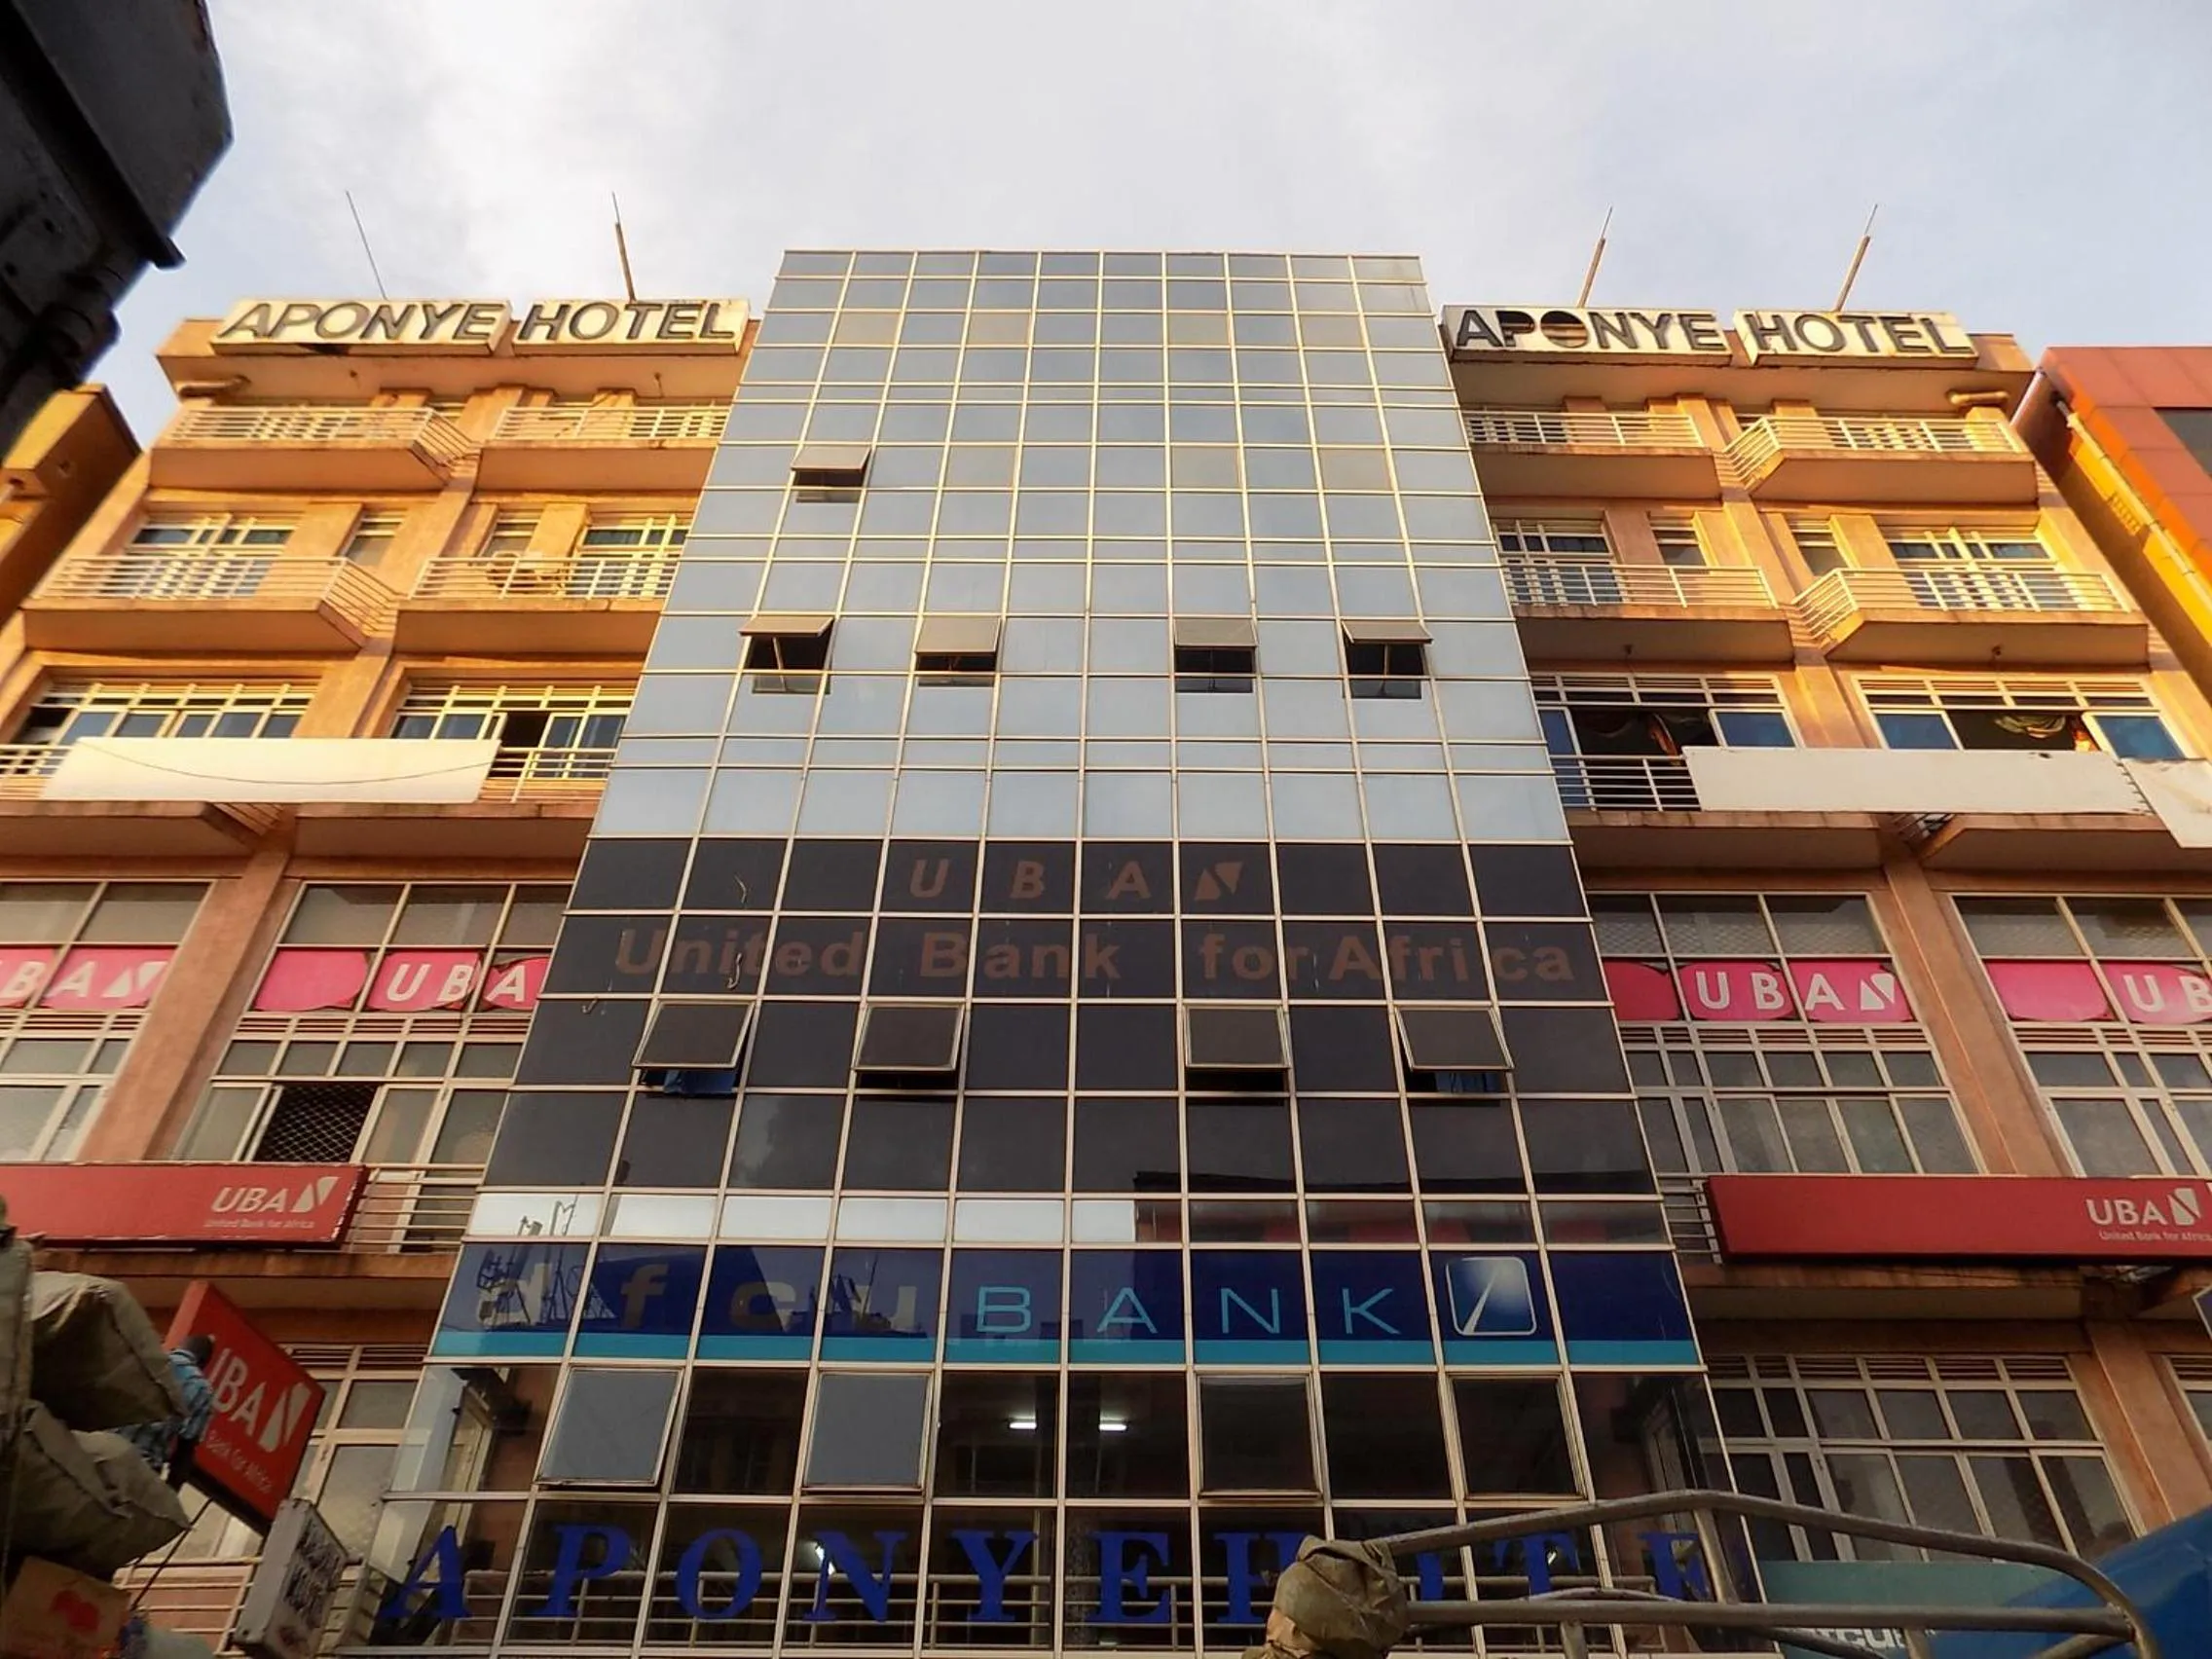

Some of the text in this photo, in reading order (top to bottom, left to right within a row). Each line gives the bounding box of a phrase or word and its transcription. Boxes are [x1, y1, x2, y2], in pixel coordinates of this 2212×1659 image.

[223, 302, 735, 342] APONYE HOTEL
[1458, 309, 1972, 355] APONYE HOTEL
[615, 927, 1575, 982] United Bank for Africa
[0, 960, 95, 999] BA
[386, 962, 527, 1004] UBA
[1694, 970, 1845, 1013] UBA
[210, 1186, 289, 1213] UBA
[2085, 1198, 2168, 1226] UBA
[976, 1285, 1403, 1337] BANK
[388, 1523, 1169, 1625] APONYE
